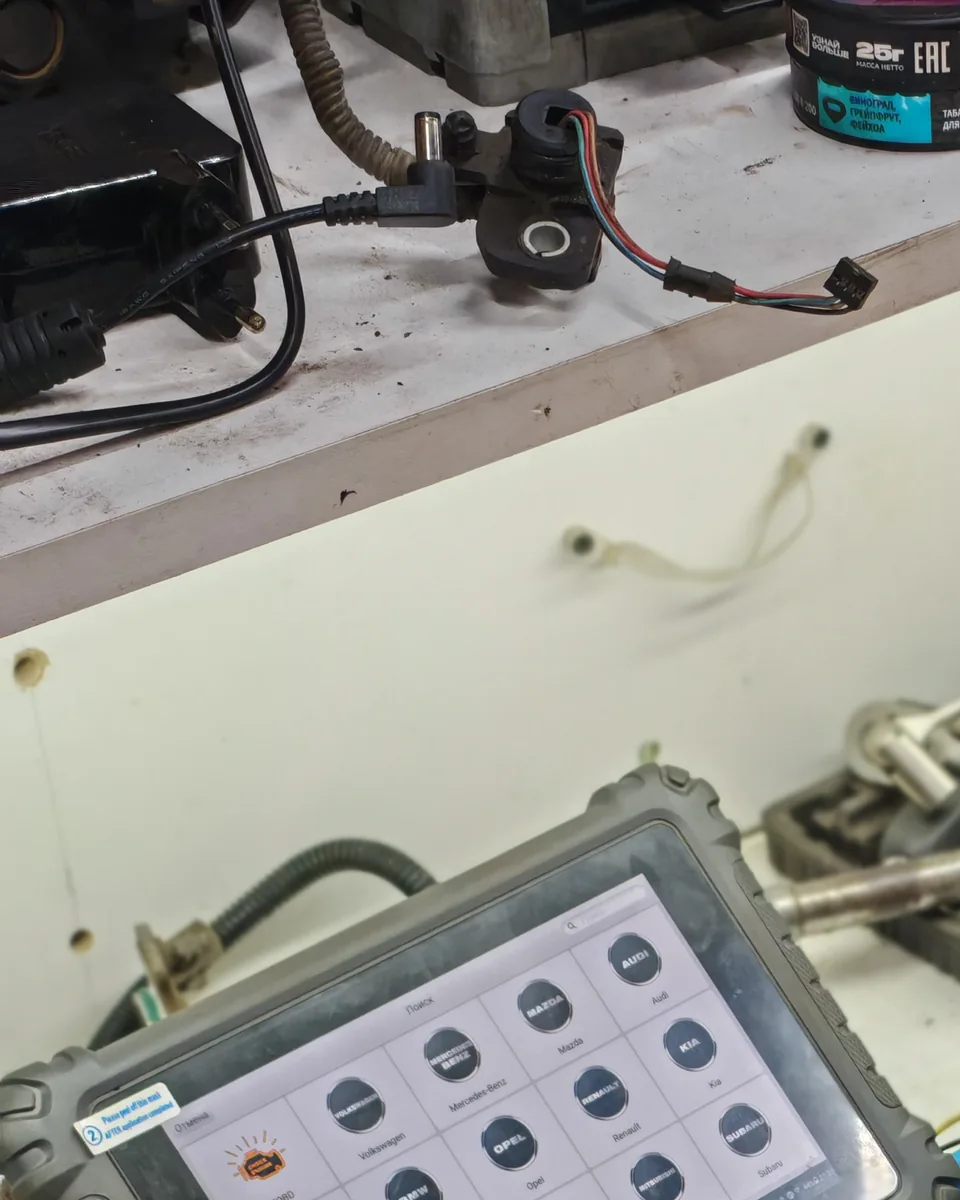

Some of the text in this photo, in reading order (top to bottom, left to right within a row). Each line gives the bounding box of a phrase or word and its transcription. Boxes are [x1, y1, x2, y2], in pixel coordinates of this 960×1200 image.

[856, 41, 905, 62] 25г
[856, 61, 904, 72] МАССА НЕТТО
[942, 120, 960, 132] ДЛЯ
[622, 949, 650, 969] AUDI
[405, 996, 435, 1015] Поиск
[526, 994, 565, 1018] MAZDA
[652, 990, 669, 1005] Audi
[557, 1037, 584, 1055] Mazda
[679, 1038, 701, 1053] KIA
[440, 1050, 472, 1070] BENZ
[582, 1080, 620, 1106] RENAULT
[708, 1079, 722, 1089] Kia
[448, 1078, 508, 1113] Mercedes-Benz
[174, 1111, 210, 1133] Отмена
[725, 1116, 766, 1143] SUBARU
[87, 1129, 99, 1141] 2
[612, 1122, 642, 1143] Renault
[358, 1132, 407, 1160] Volkswagen
[493, 1133, 527, 1154] OPEL
[757, 1160, 784, 1178] Subaru
[526, 1176, 545, 1190] Opel
